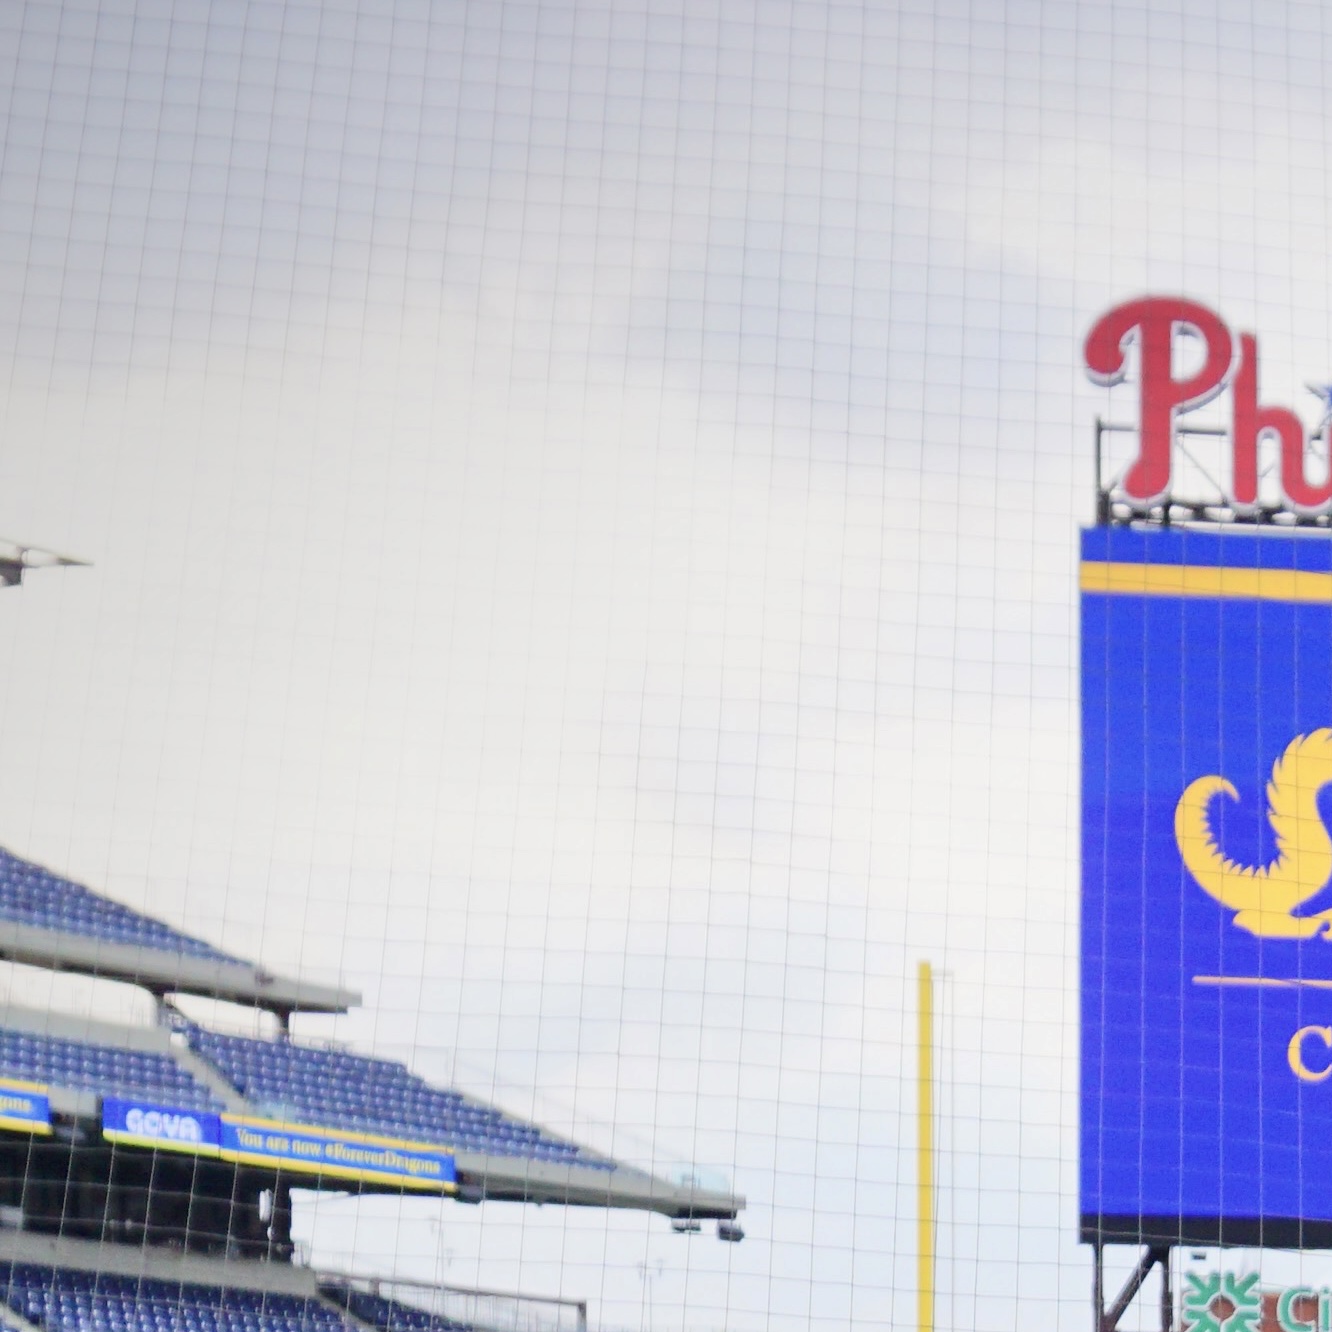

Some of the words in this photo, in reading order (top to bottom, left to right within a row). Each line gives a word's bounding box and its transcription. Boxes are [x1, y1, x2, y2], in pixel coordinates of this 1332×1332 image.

[125, 1108, 203, 1141] GOYA
[236, 1127, 262, 1148] You
[266, 1135, 288, 1151] are
[292, 1139, 321, 1157] now
